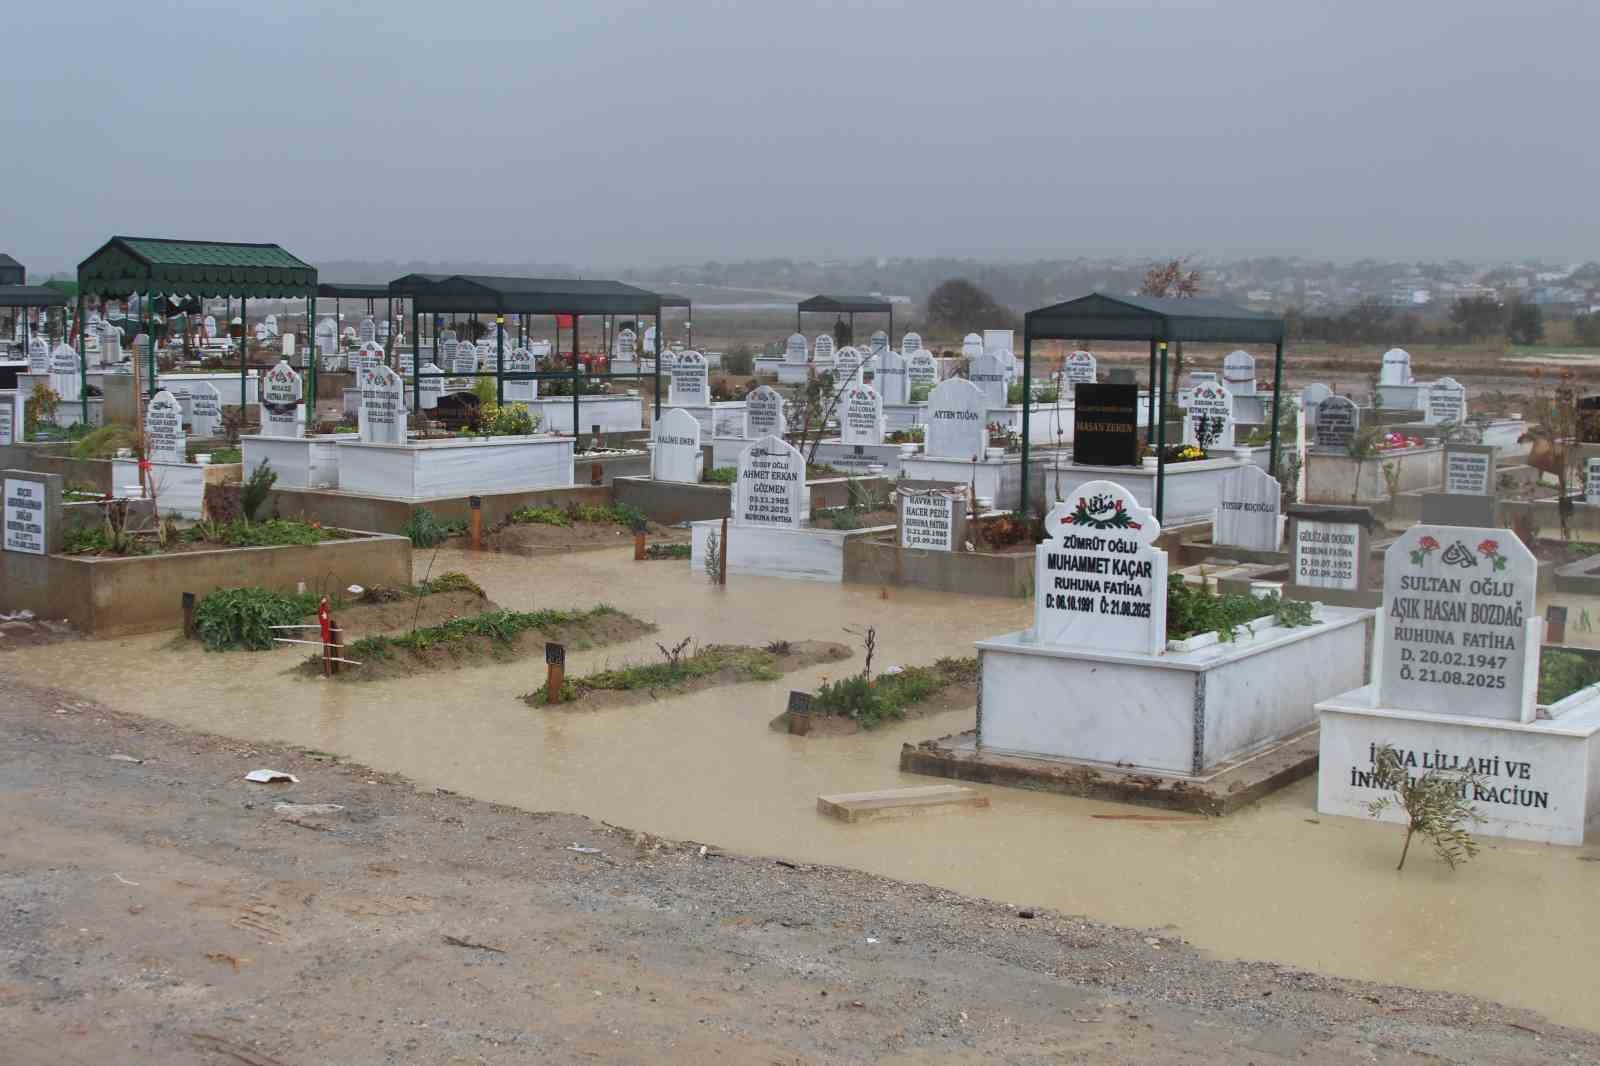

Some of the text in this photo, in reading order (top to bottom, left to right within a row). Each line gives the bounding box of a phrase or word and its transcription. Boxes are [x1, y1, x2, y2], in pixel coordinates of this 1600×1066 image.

[743, 470, 798, 481] AHMET ERKAN
[772, 461, 789, 470] OĞLU
[753, 482, 786, 494] GÖZMEN
[1063, 534, 1138, 554] ZÜMRÜT OĞLU
[1047, 553, 1152, 581] MUHAMMET KAÇAR
[1055, 576, 1102, 594] RUHUNA
[1401, 575, 1515, 598] SULTAN OĞLU
[1390, 597, 1524, 628] AŞIK HASAN BOZDAĞ
[1394, 626, 1516, 651] RUHUNA FATİHA
[1401, 648, 1507, 670] D. 20.02.1947
[1400, 664, 1506, 690] Ö. 21.08.2025
[1369, 742, 1531, 780] İNA LİLLAHİ VE
[1472, 784, 1550, 809] RACİUN
